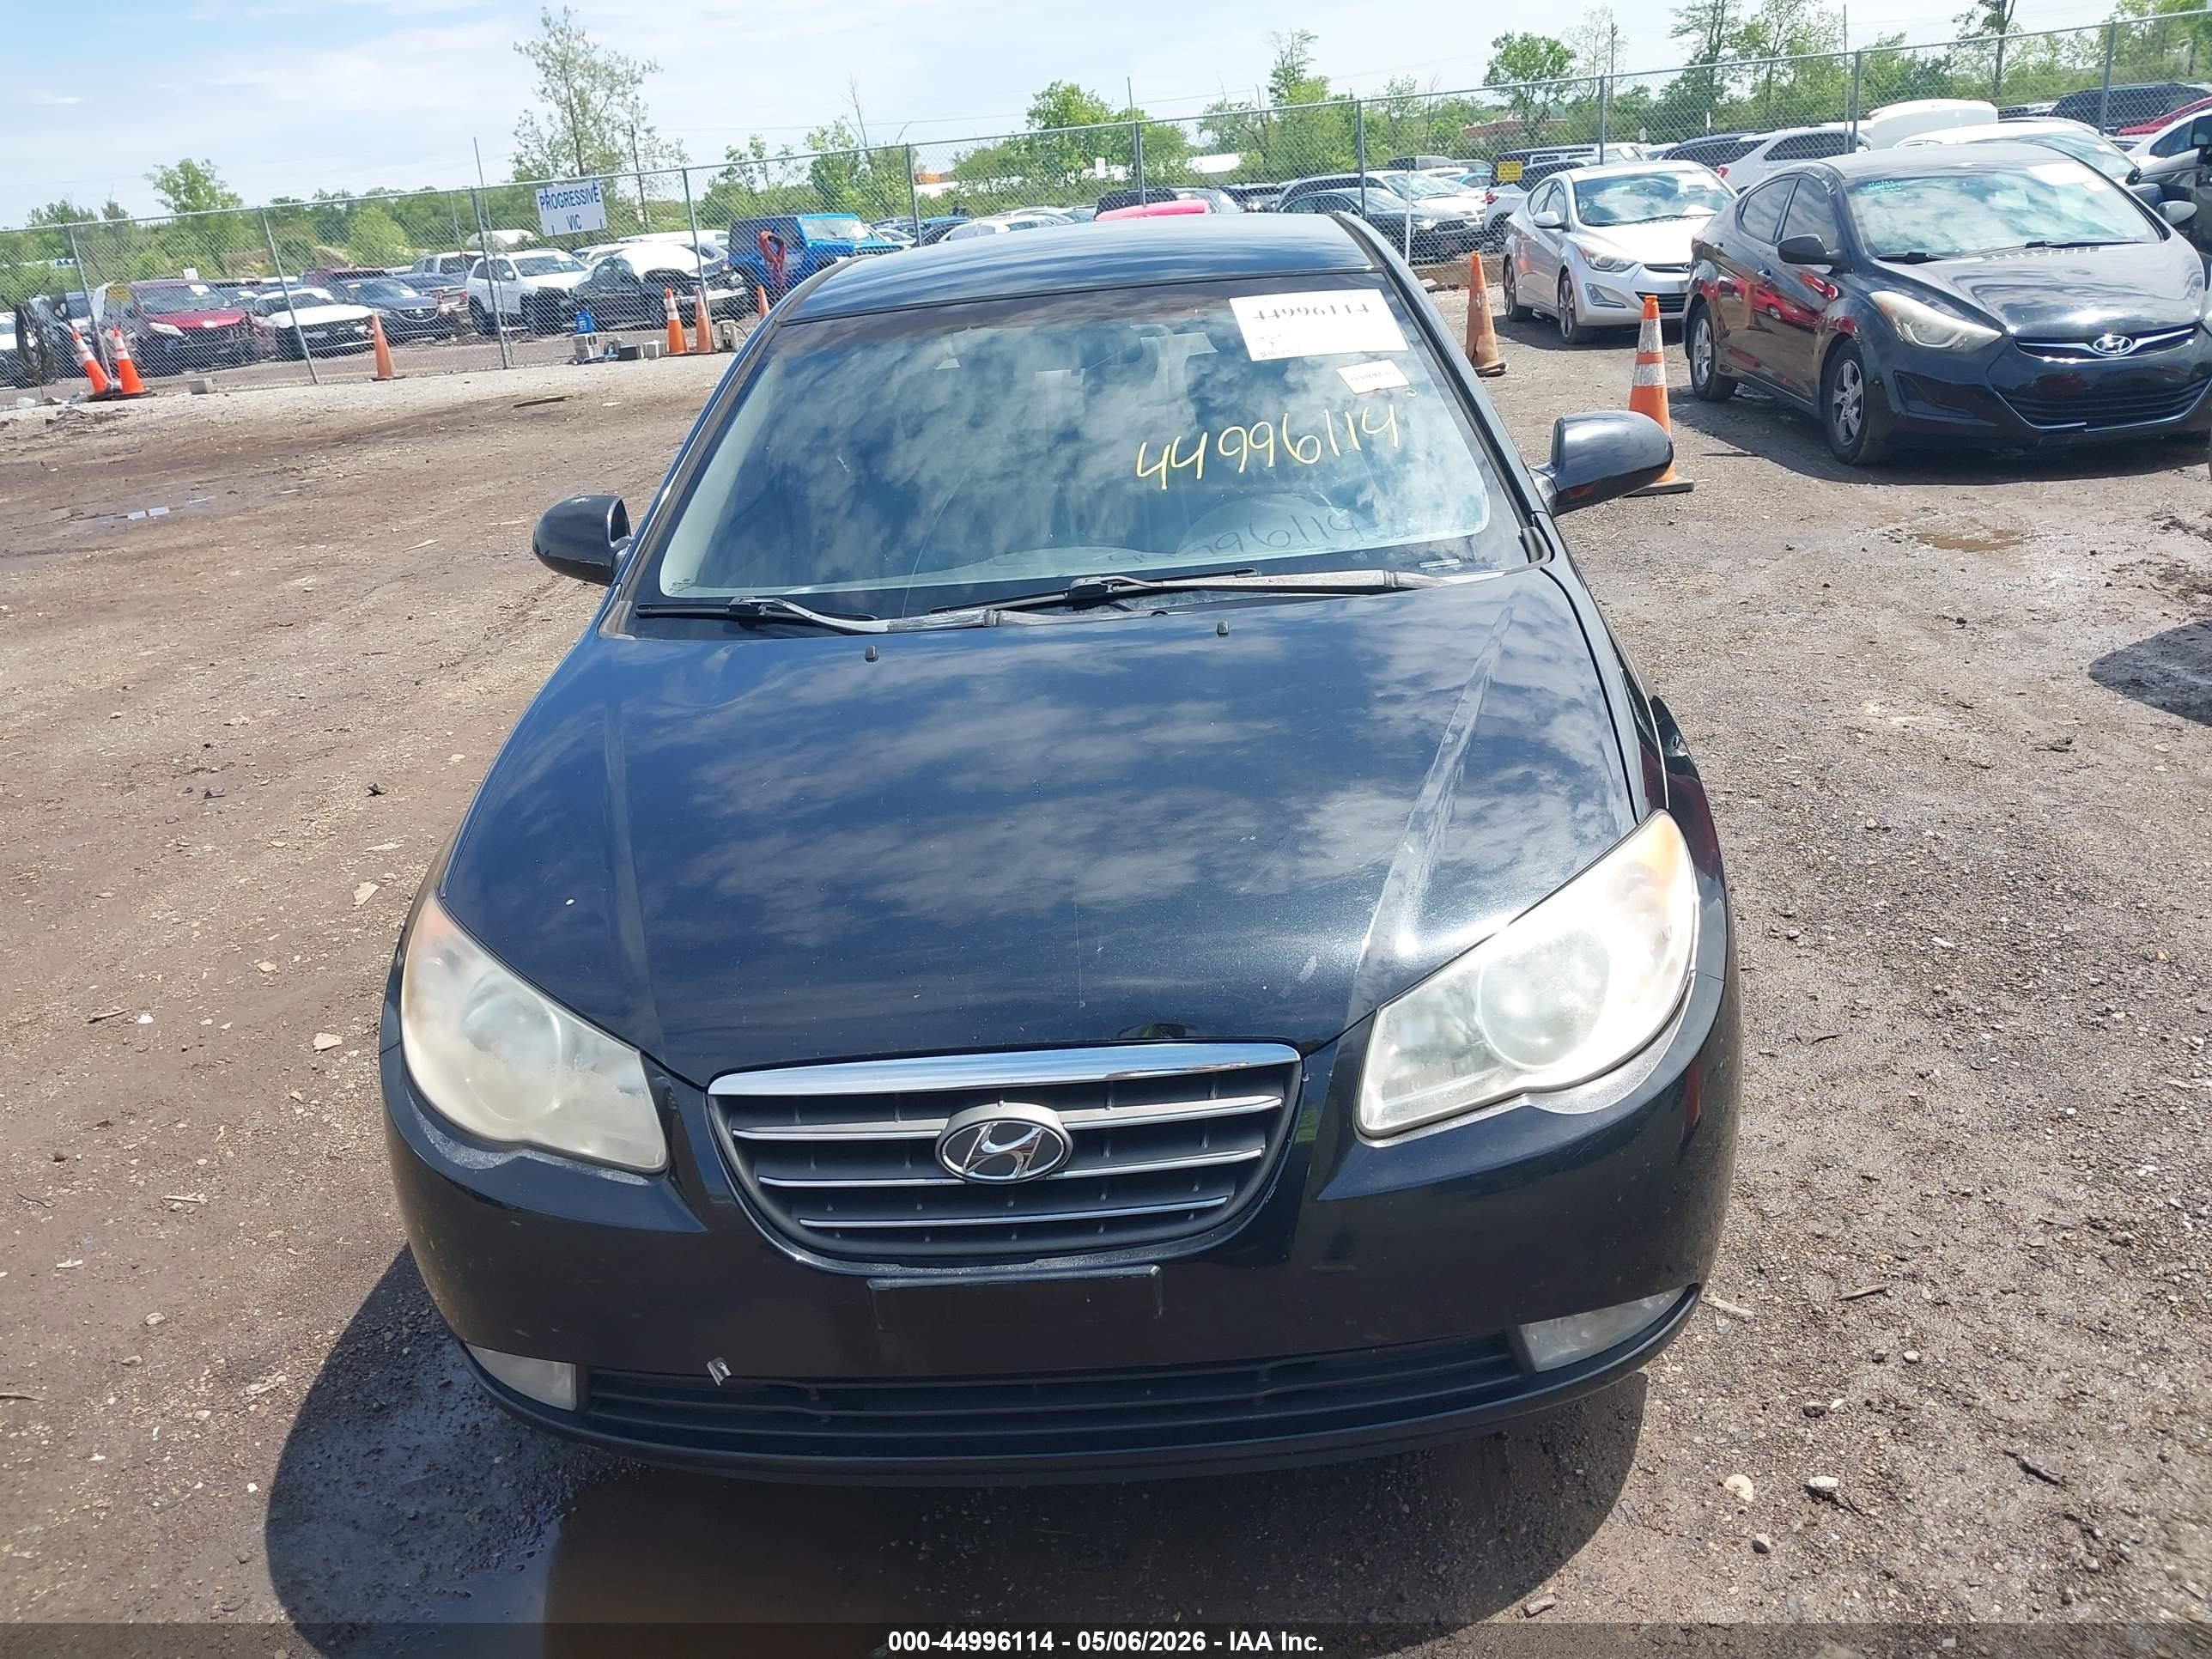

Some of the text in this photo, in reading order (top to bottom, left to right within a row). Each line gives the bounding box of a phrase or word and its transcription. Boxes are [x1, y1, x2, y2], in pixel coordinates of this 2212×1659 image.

[539, 185, 601, 211] PROGRESSIVE
[566, 214, 582, 231] VIC
[1136, 404, 1399, 490] 44996114
